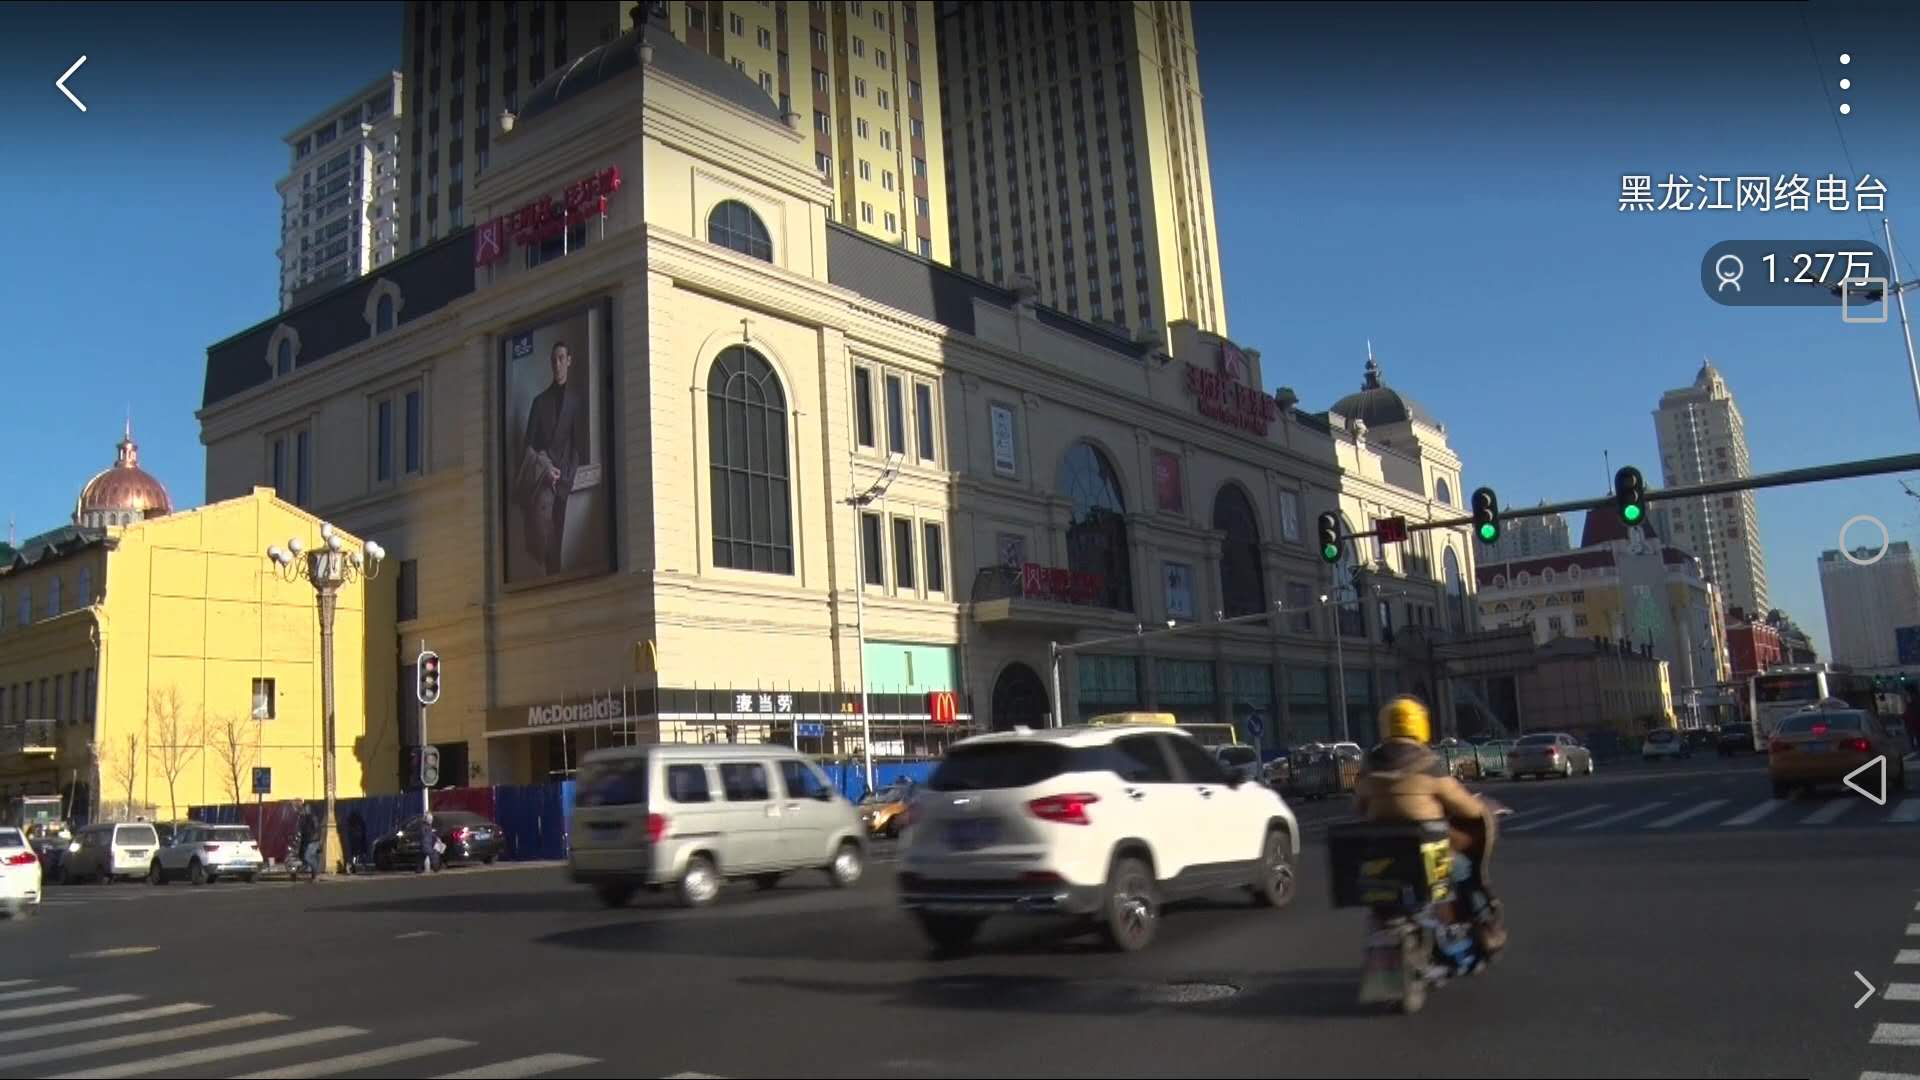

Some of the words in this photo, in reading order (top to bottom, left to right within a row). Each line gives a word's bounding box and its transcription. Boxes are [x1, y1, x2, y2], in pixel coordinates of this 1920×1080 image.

[528, 699, 622, 726] McDonald's
[736, 693, 793, 713] 麦当劳
